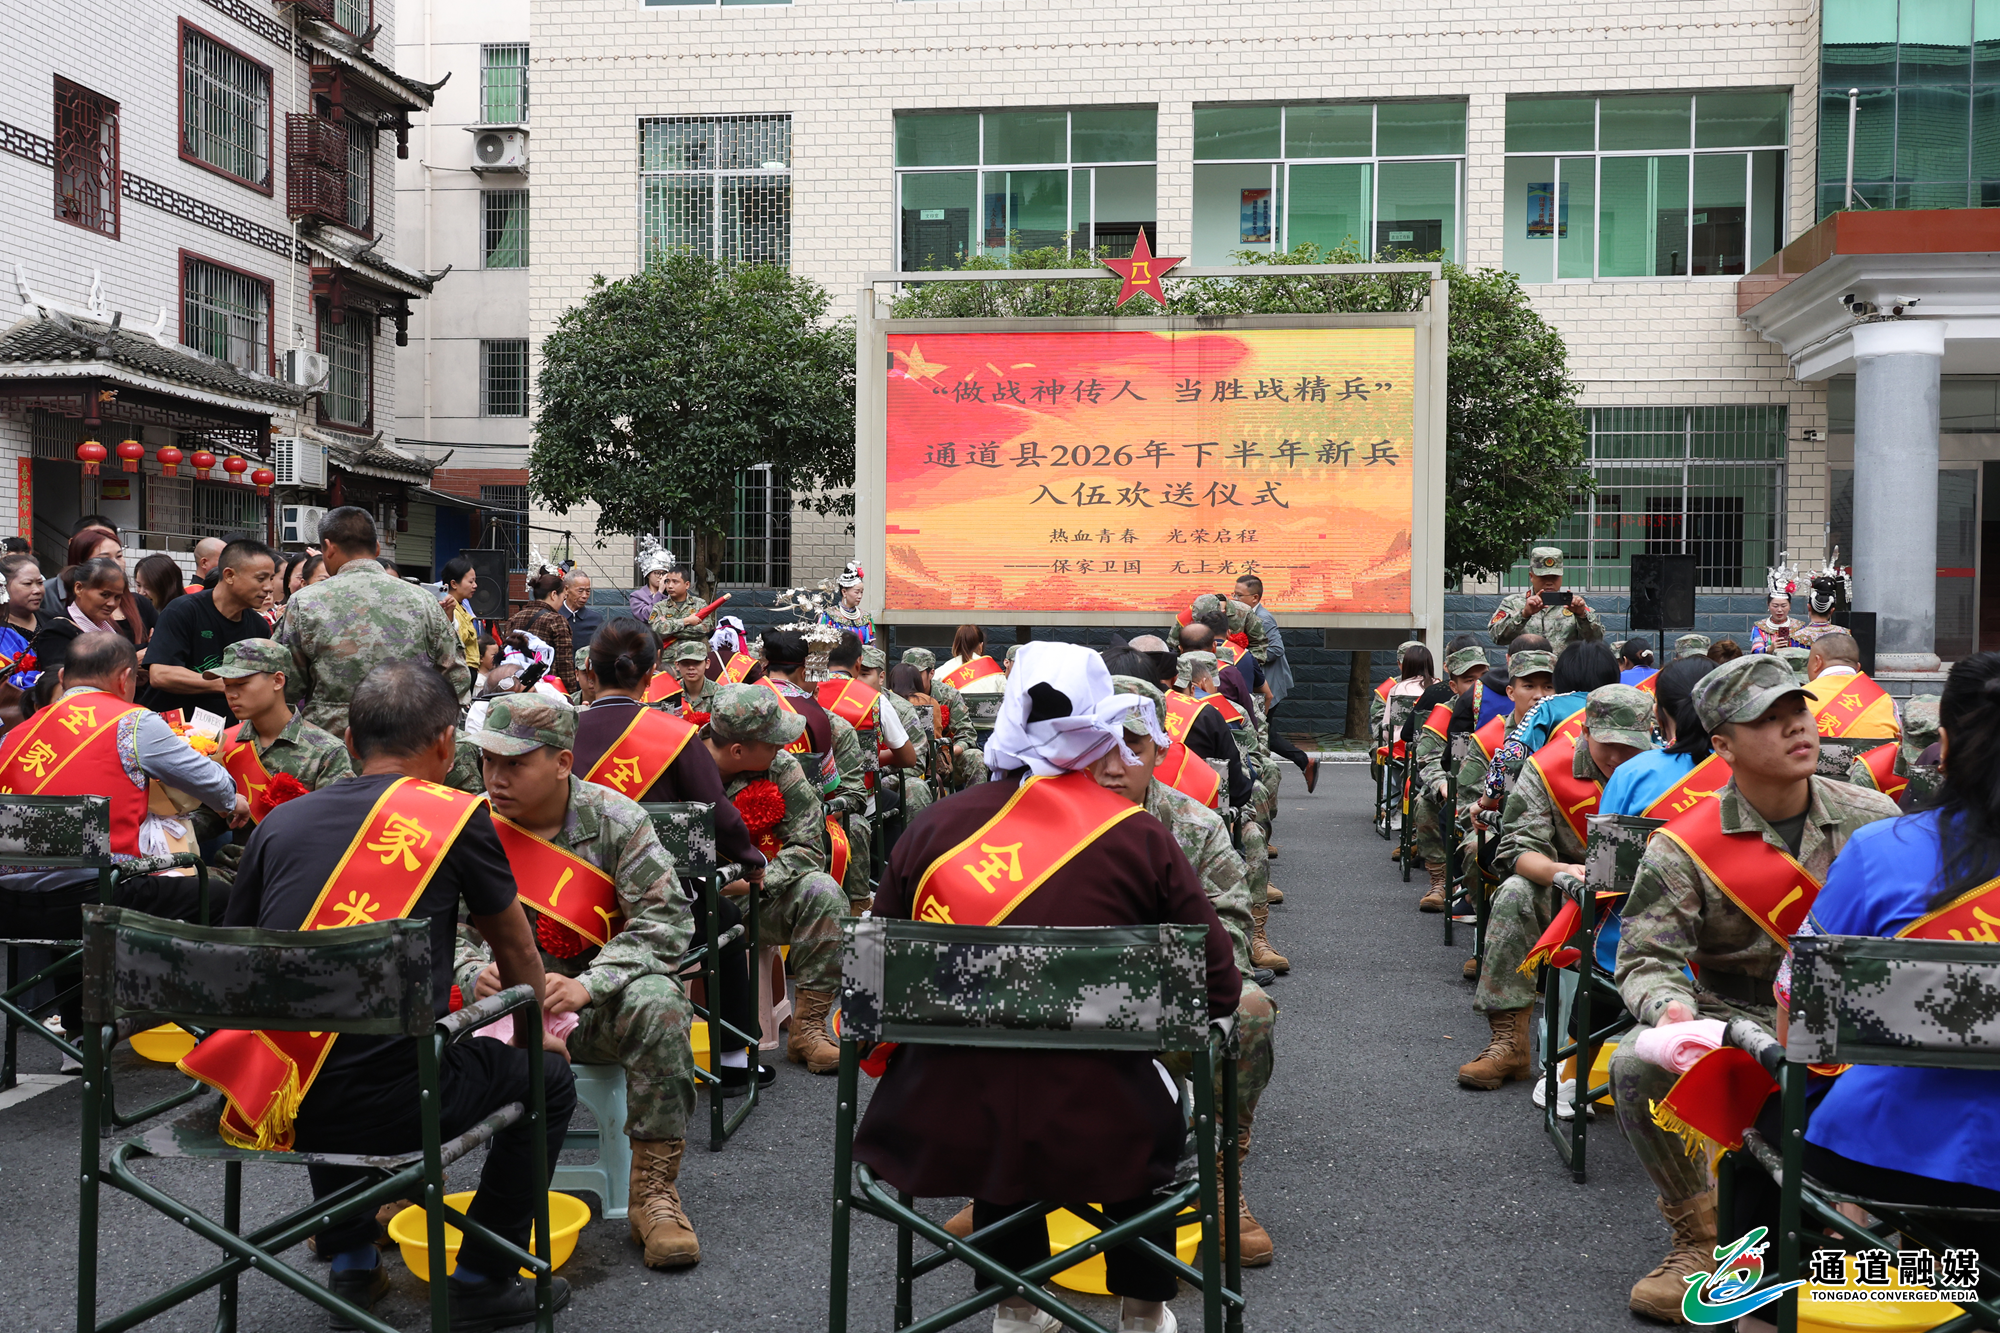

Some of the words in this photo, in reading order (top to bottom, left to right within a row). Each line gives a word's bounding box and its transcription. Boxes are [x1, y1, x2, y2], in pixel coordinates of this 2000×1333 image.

[1131, 261, 1152, 285] 八一
[923, 438, 1400, 469] 通道县2026年下半年新兵
[1029, 481, 1289, 509] 入伍欢送仪式
[1049, 528, 1140, 544] 热血青春
[1166, 528, 1259, 544] 光荣启程
[195, 711, 222, 728] FLOWERS
[1817, 692, 1863, 737] 全家
[1, 704, 98, 794] 全家
[226, 743, 267, 805] 一人
[604, 756, 643, 792] 全
[1569, 796, 1597, 814] 一
[1767, 885, 1803, 925] 一
